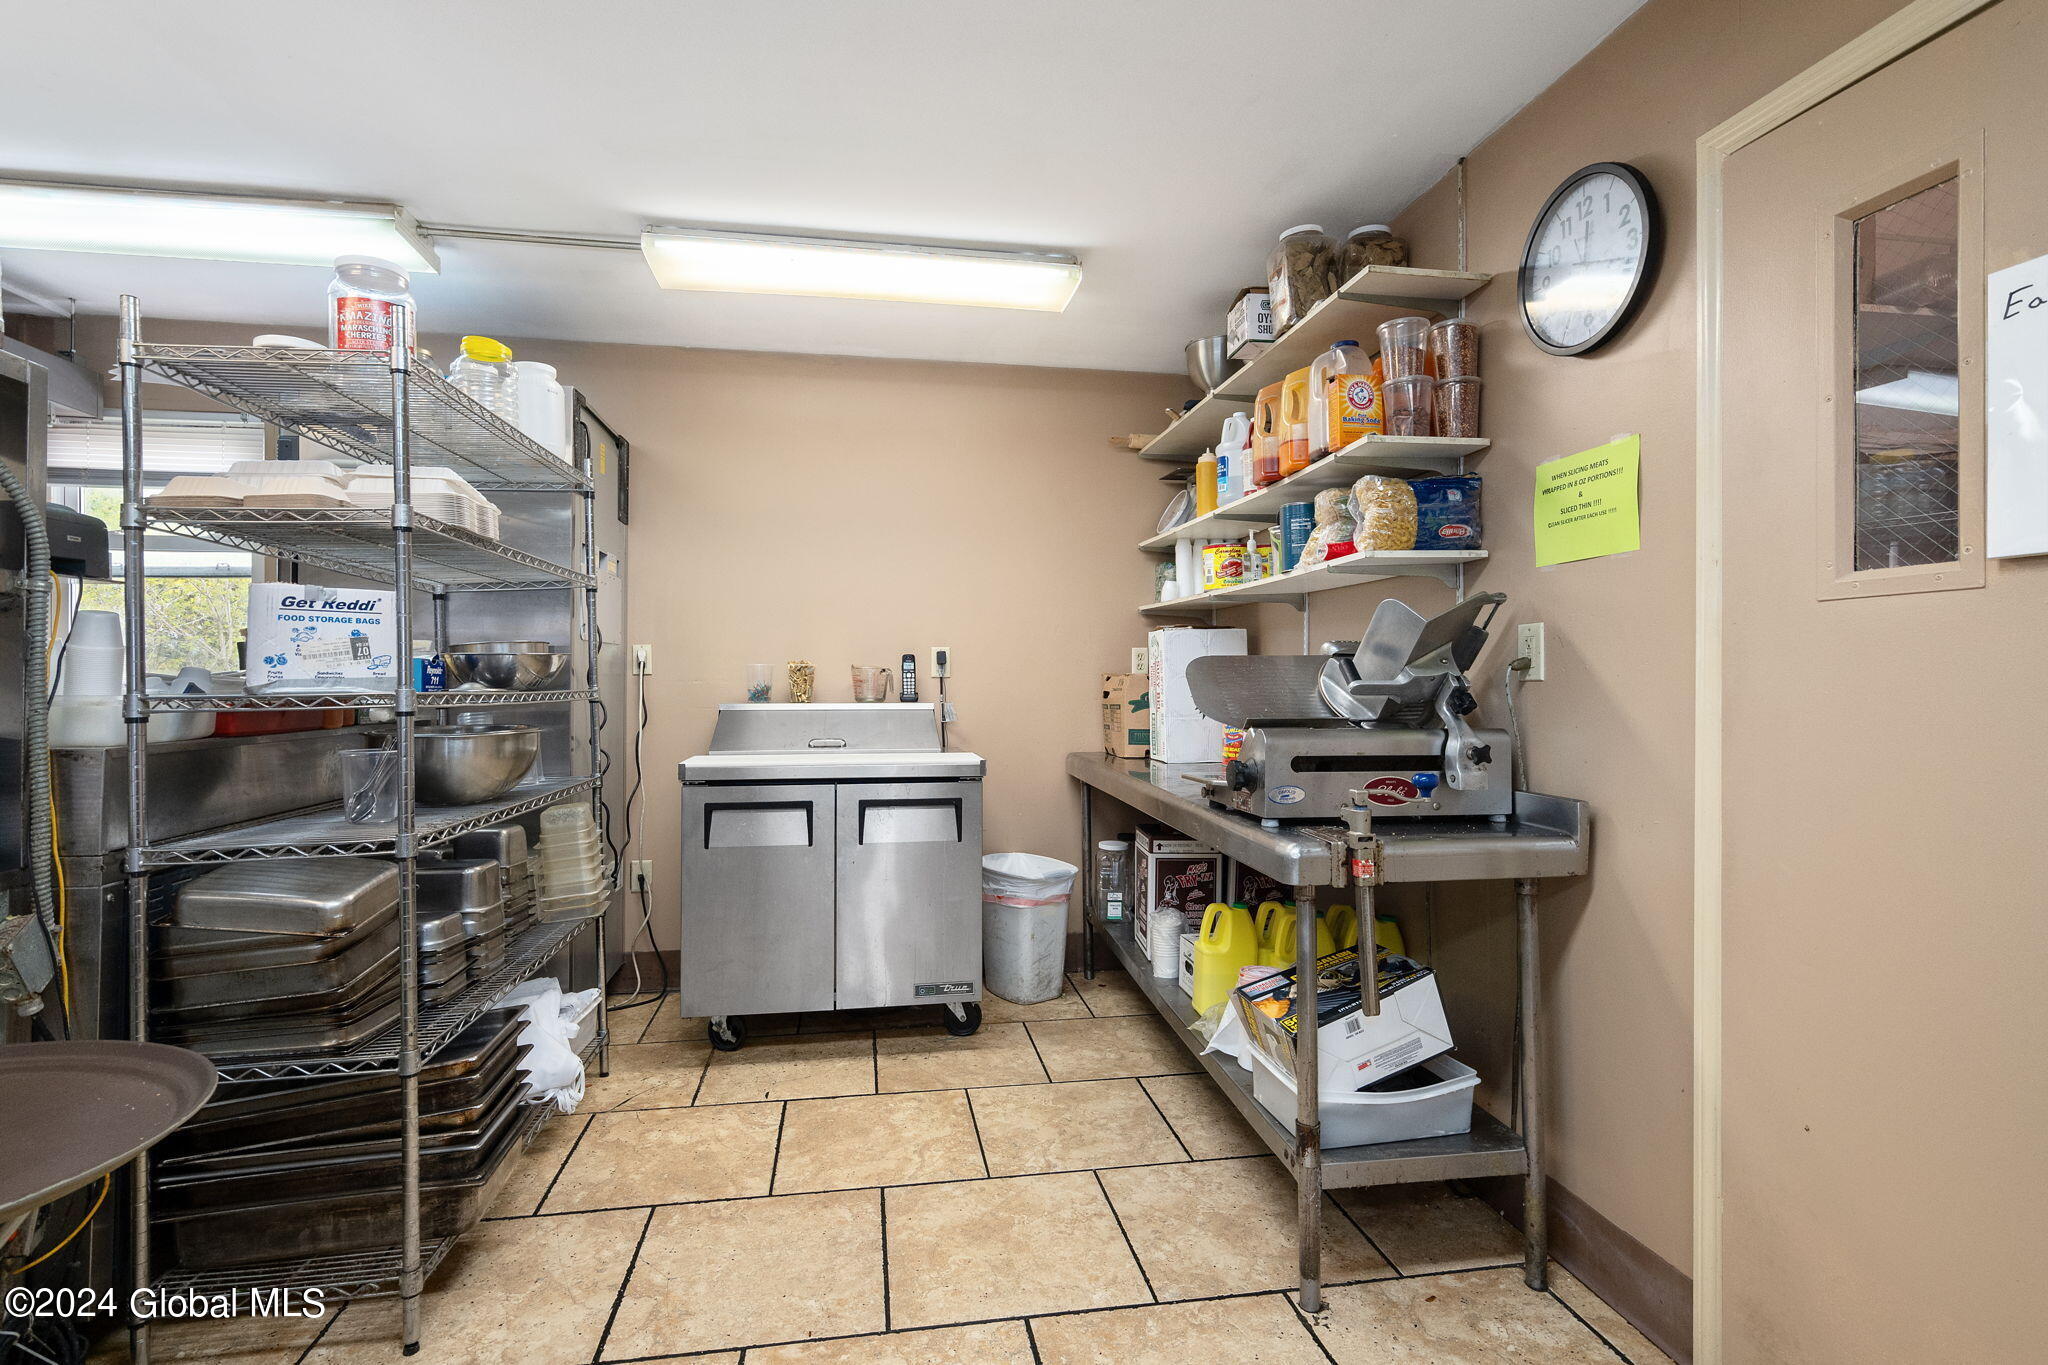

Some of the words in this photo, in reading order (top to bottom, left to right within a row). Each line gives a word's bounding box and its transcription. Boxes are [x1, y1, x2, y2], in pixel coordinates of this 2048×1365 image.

[1576, 195, 1594, 222] 12
[1618, 204, 1631, 229] 2
[1560, 216, 1572, 239] 11
[345, 332, 386, 340] CHERRIES
[1551, 472, 1568, 482] WHEN
[1568, 464, 1588, 476] SLICING
[1590, 458, 1608, 469] MEATS
[1542, 484, 1566, 496] WRAPPED
[1587, 467, 1624, 483] PORTIONS!!!
[1560, 505, 1578, 514] SLICED
[1578, 502, 1592, 510] THIN
[281, 596, 316, 610] Get
[278, 614, 305, 622] FOOD
[308, 615, 353, 624] STORAGE
[431, 676, 440, 684] 711
